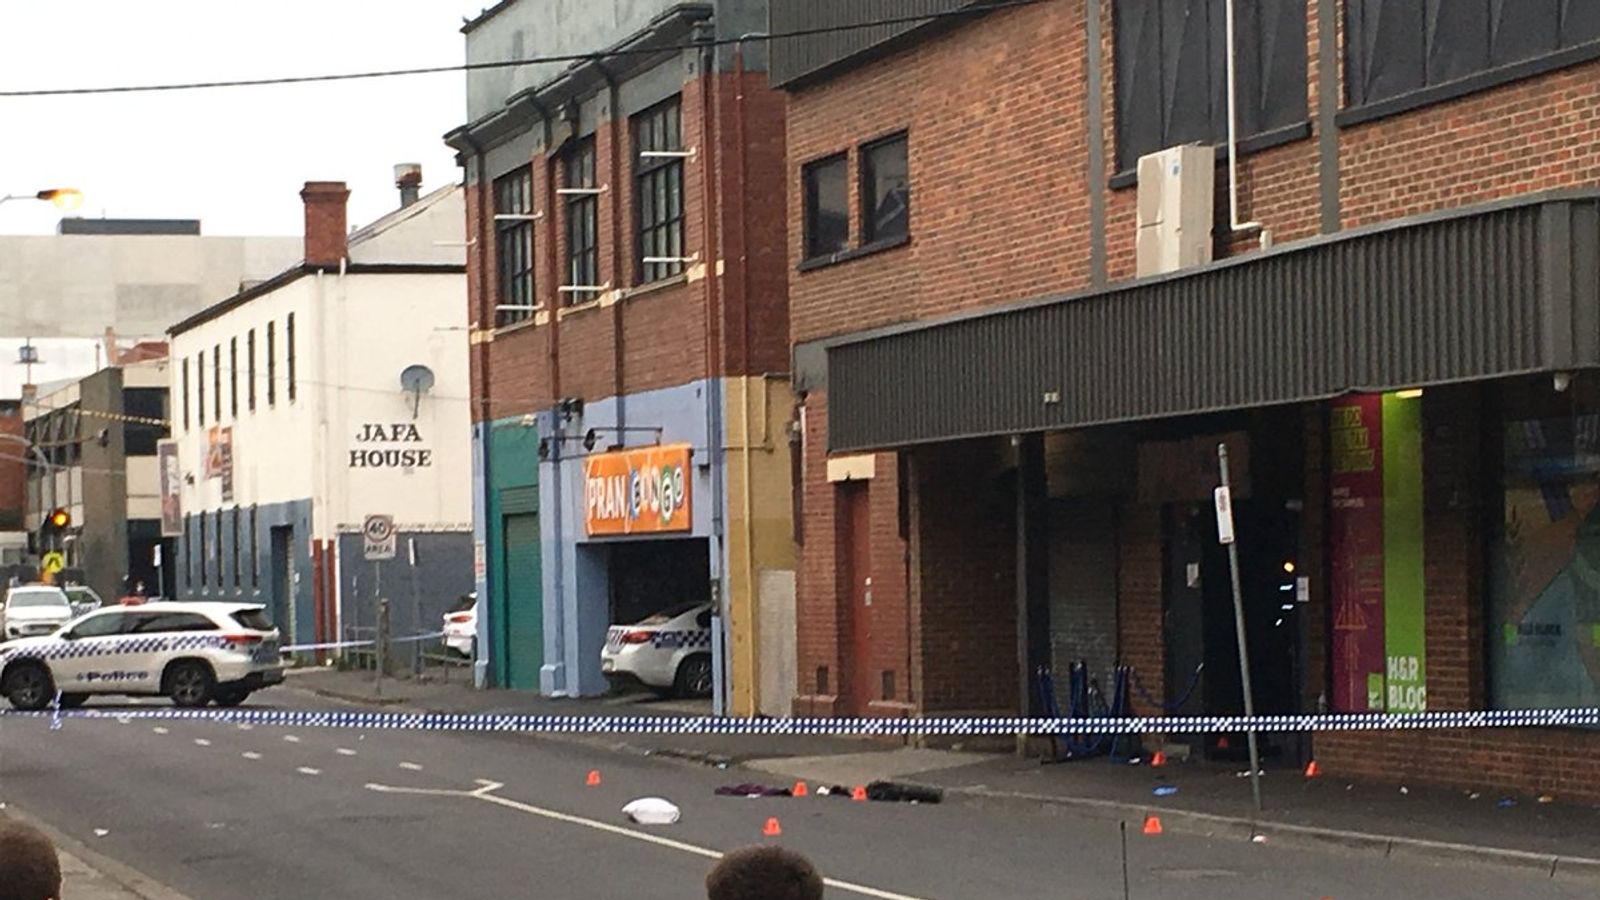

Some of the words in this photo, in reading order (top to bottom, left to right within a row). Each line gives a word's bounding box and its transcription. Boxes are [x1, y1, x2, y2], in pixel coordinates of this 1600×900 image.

[356, 423, 422, 442] JAFA
[349, 449, 432, 468] HOUSE
[588, 475, 627, 520] PRAN
[1387, 656, 1419, 681] H&R
